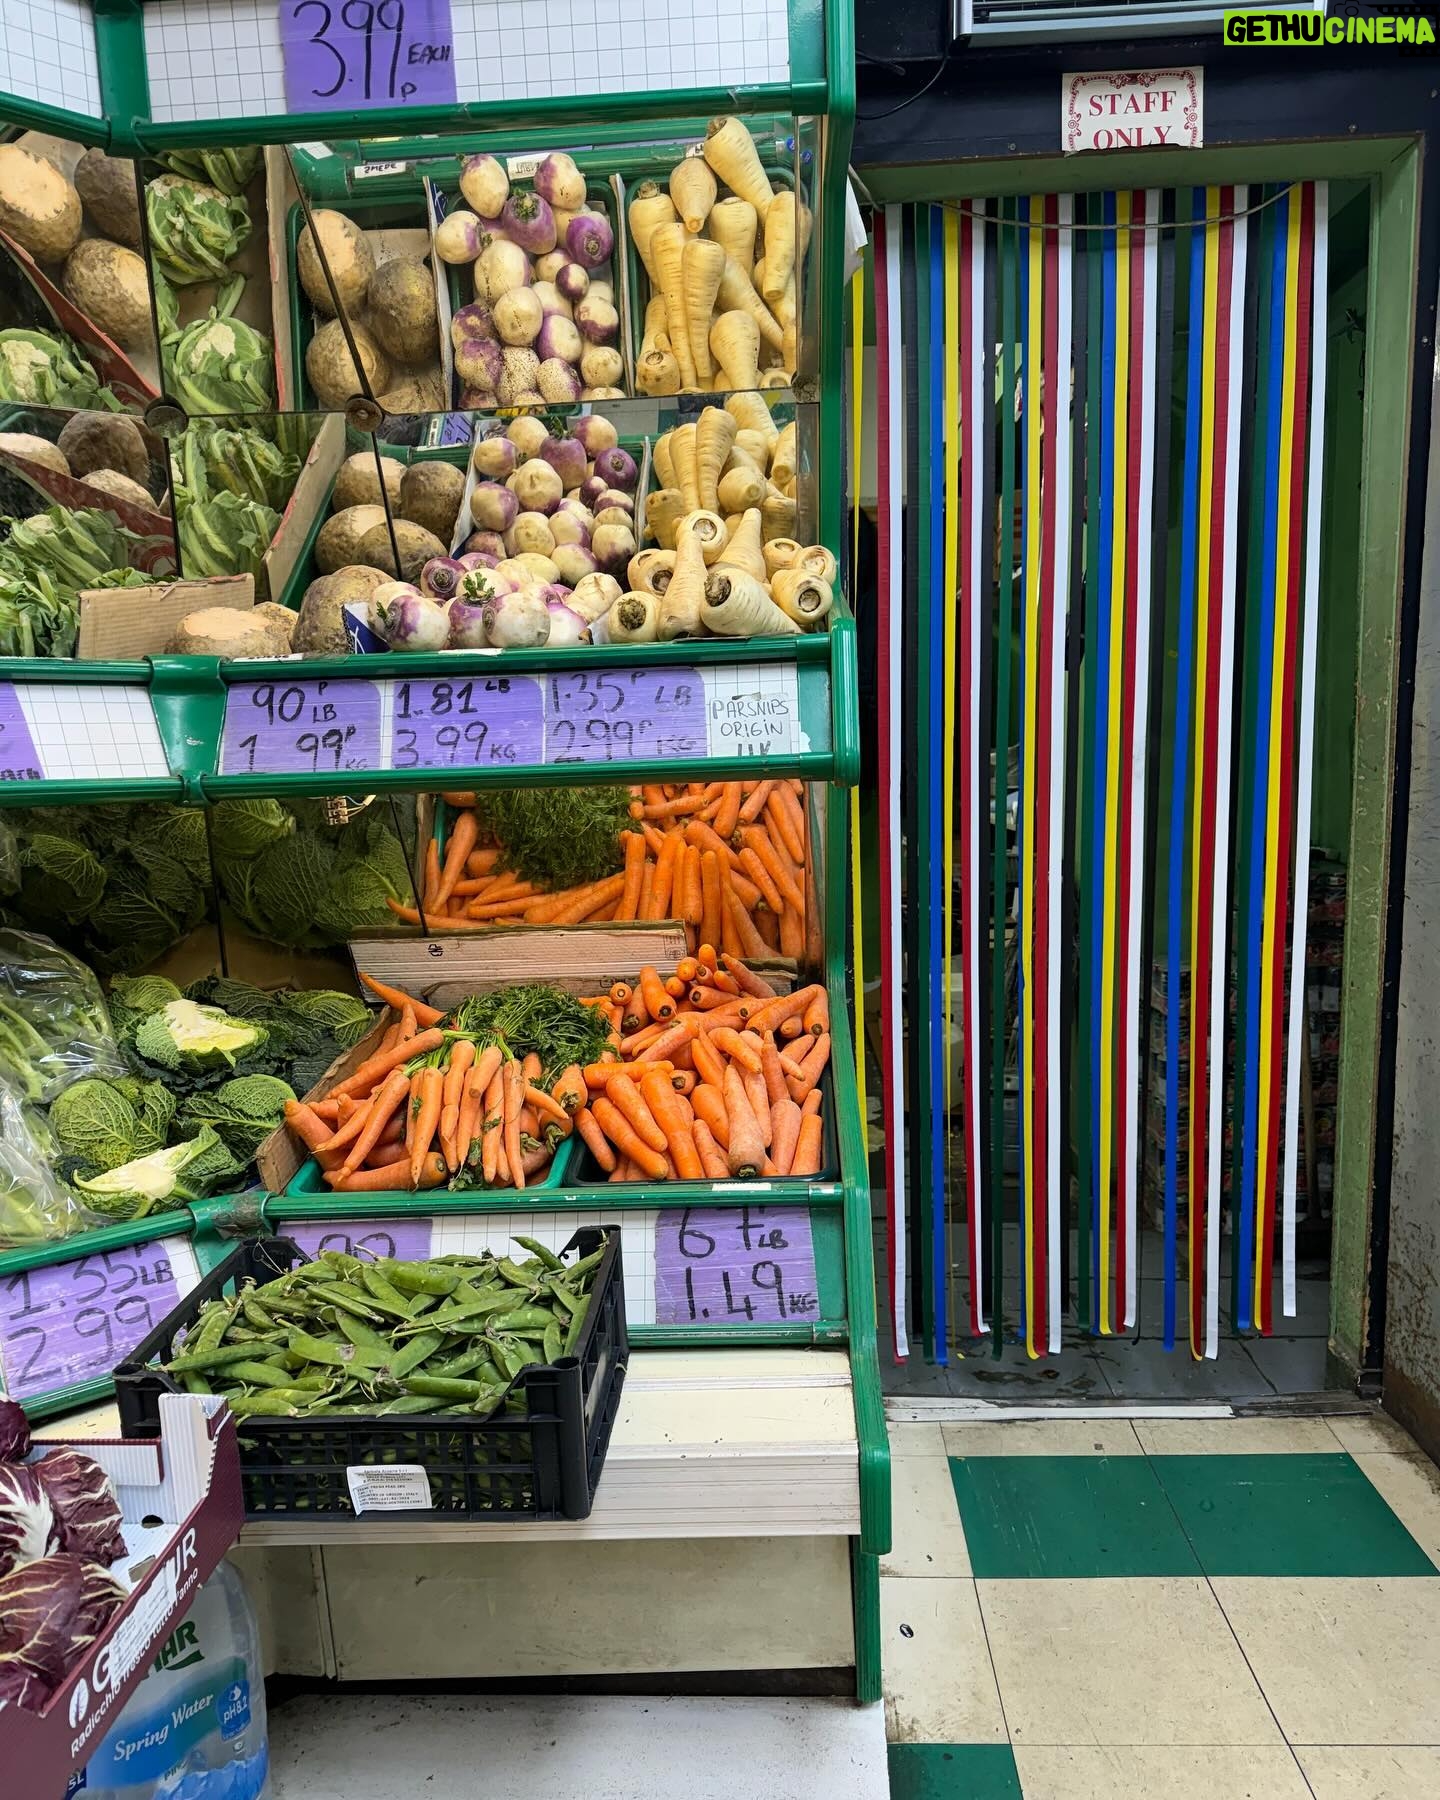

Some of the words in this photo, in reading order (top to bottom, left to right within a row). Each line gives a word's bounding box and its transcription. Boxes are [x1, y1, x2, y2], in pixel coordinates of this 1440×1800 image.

[1089, 90, 1176, 117] STAFF
[1093, 126, 1172, 150] ONLY
[252, 684, 305, 725] 90
[397, 682, 478, 718] 1.81
[485, 679, 510, 693] LB
[655, 685, 692, 706] LB
[312, 703, 337, 723] LB
[712, 699, 789, 719] PARSNIPS
[720, 719, 783, 737] ORIGIN
[490, 743, 516, 762] KG
[758, 1229, 788, 1249] LB
[141, 1259, 174, 1285] LB
[685, 1261, 787, 1320] 1.49
[71, 1682, 121, 1758] Radicchio
[113, 1724, 169, 1761] Spring
[171, 1694, 214, 1728] Water
